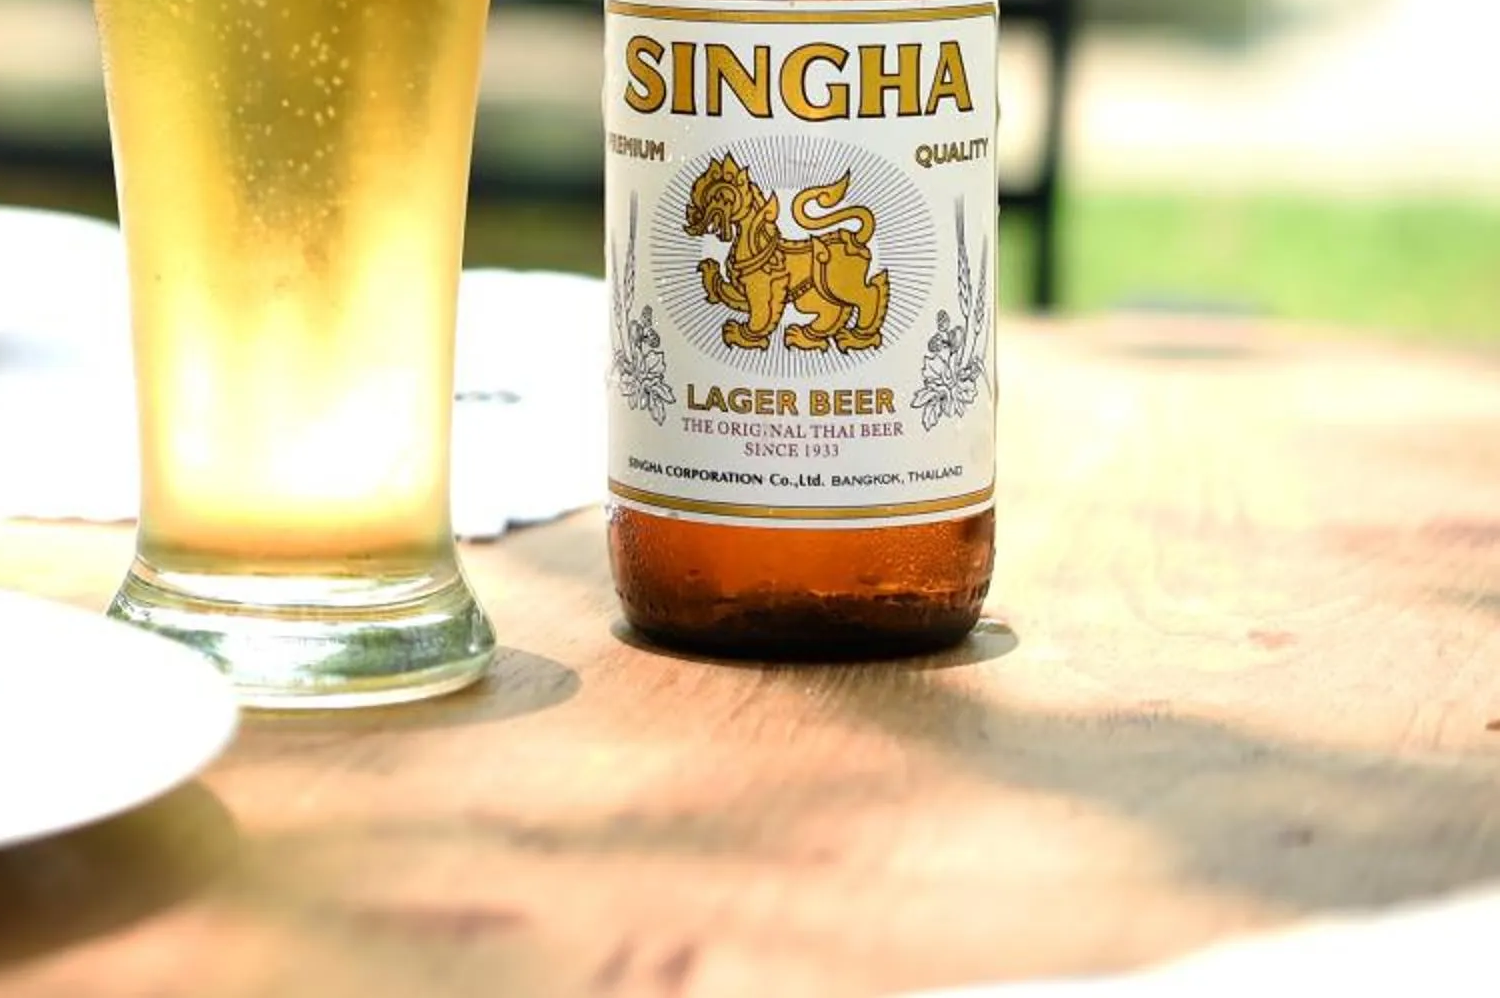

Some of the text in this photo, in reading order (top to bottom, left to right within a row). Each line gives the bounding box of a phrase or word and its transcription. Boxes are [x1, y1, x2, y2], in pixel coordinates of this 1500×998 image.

[624, 35, 974, 122] SINGHA
[915, 137, 989, 168] QUALITY
[686, 383, 897, 417] LAGER BEER
[682, 417, 713, 434] THE
[810, 423, 856, 439] THAI
[860, 421, 904, 438] BEER
[744, 442, 840, 459] SINCE 1933
[628, 456, 663, 475] SINGHA
[665, 465, 764, 485] CORPORATION
[831, 473, 905, 487] BANGKOK,
[907, 465, 964, 482] THAILAND
